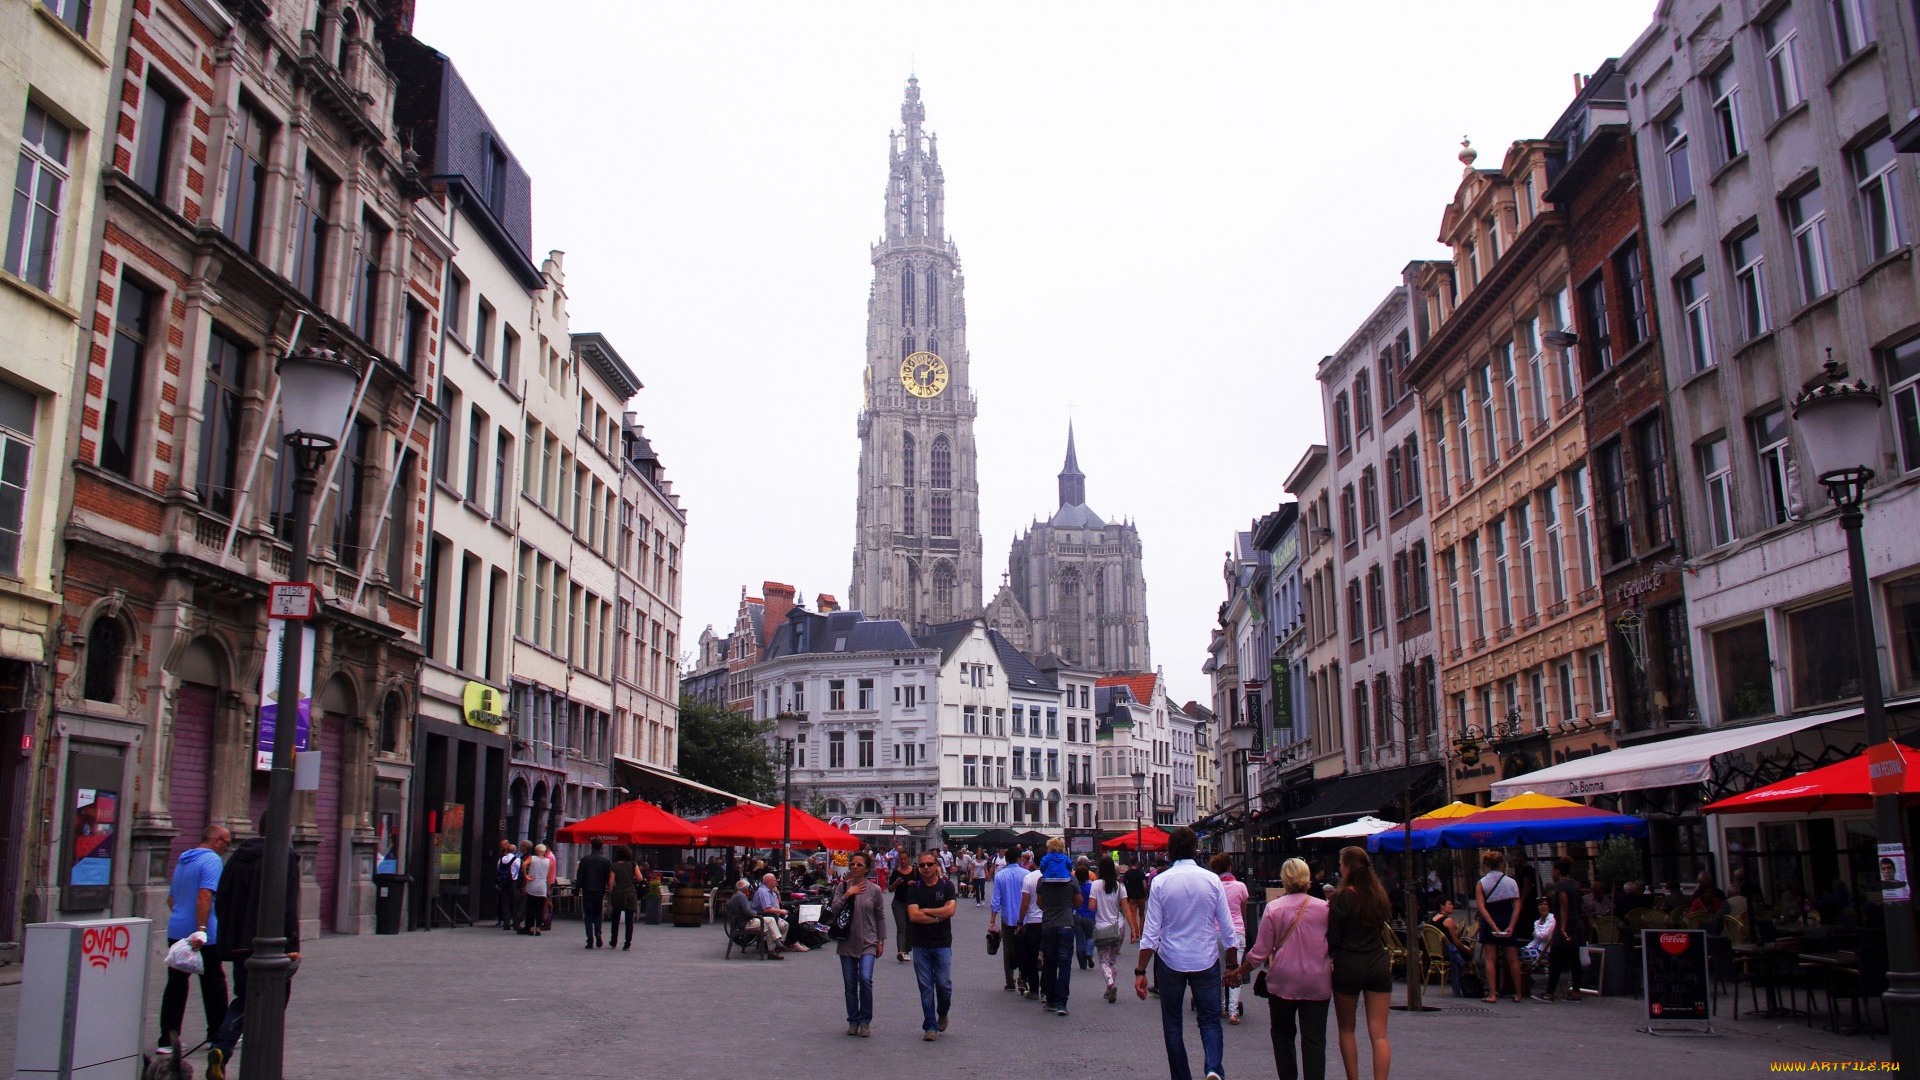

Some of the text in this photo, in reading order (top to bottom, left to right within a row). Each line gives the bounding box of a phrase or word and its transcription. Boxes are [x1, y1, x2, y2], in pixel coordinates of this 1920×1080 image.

[280, 586, 303, 595] H150
[1569, 780, 1605, 794] De Bomma
